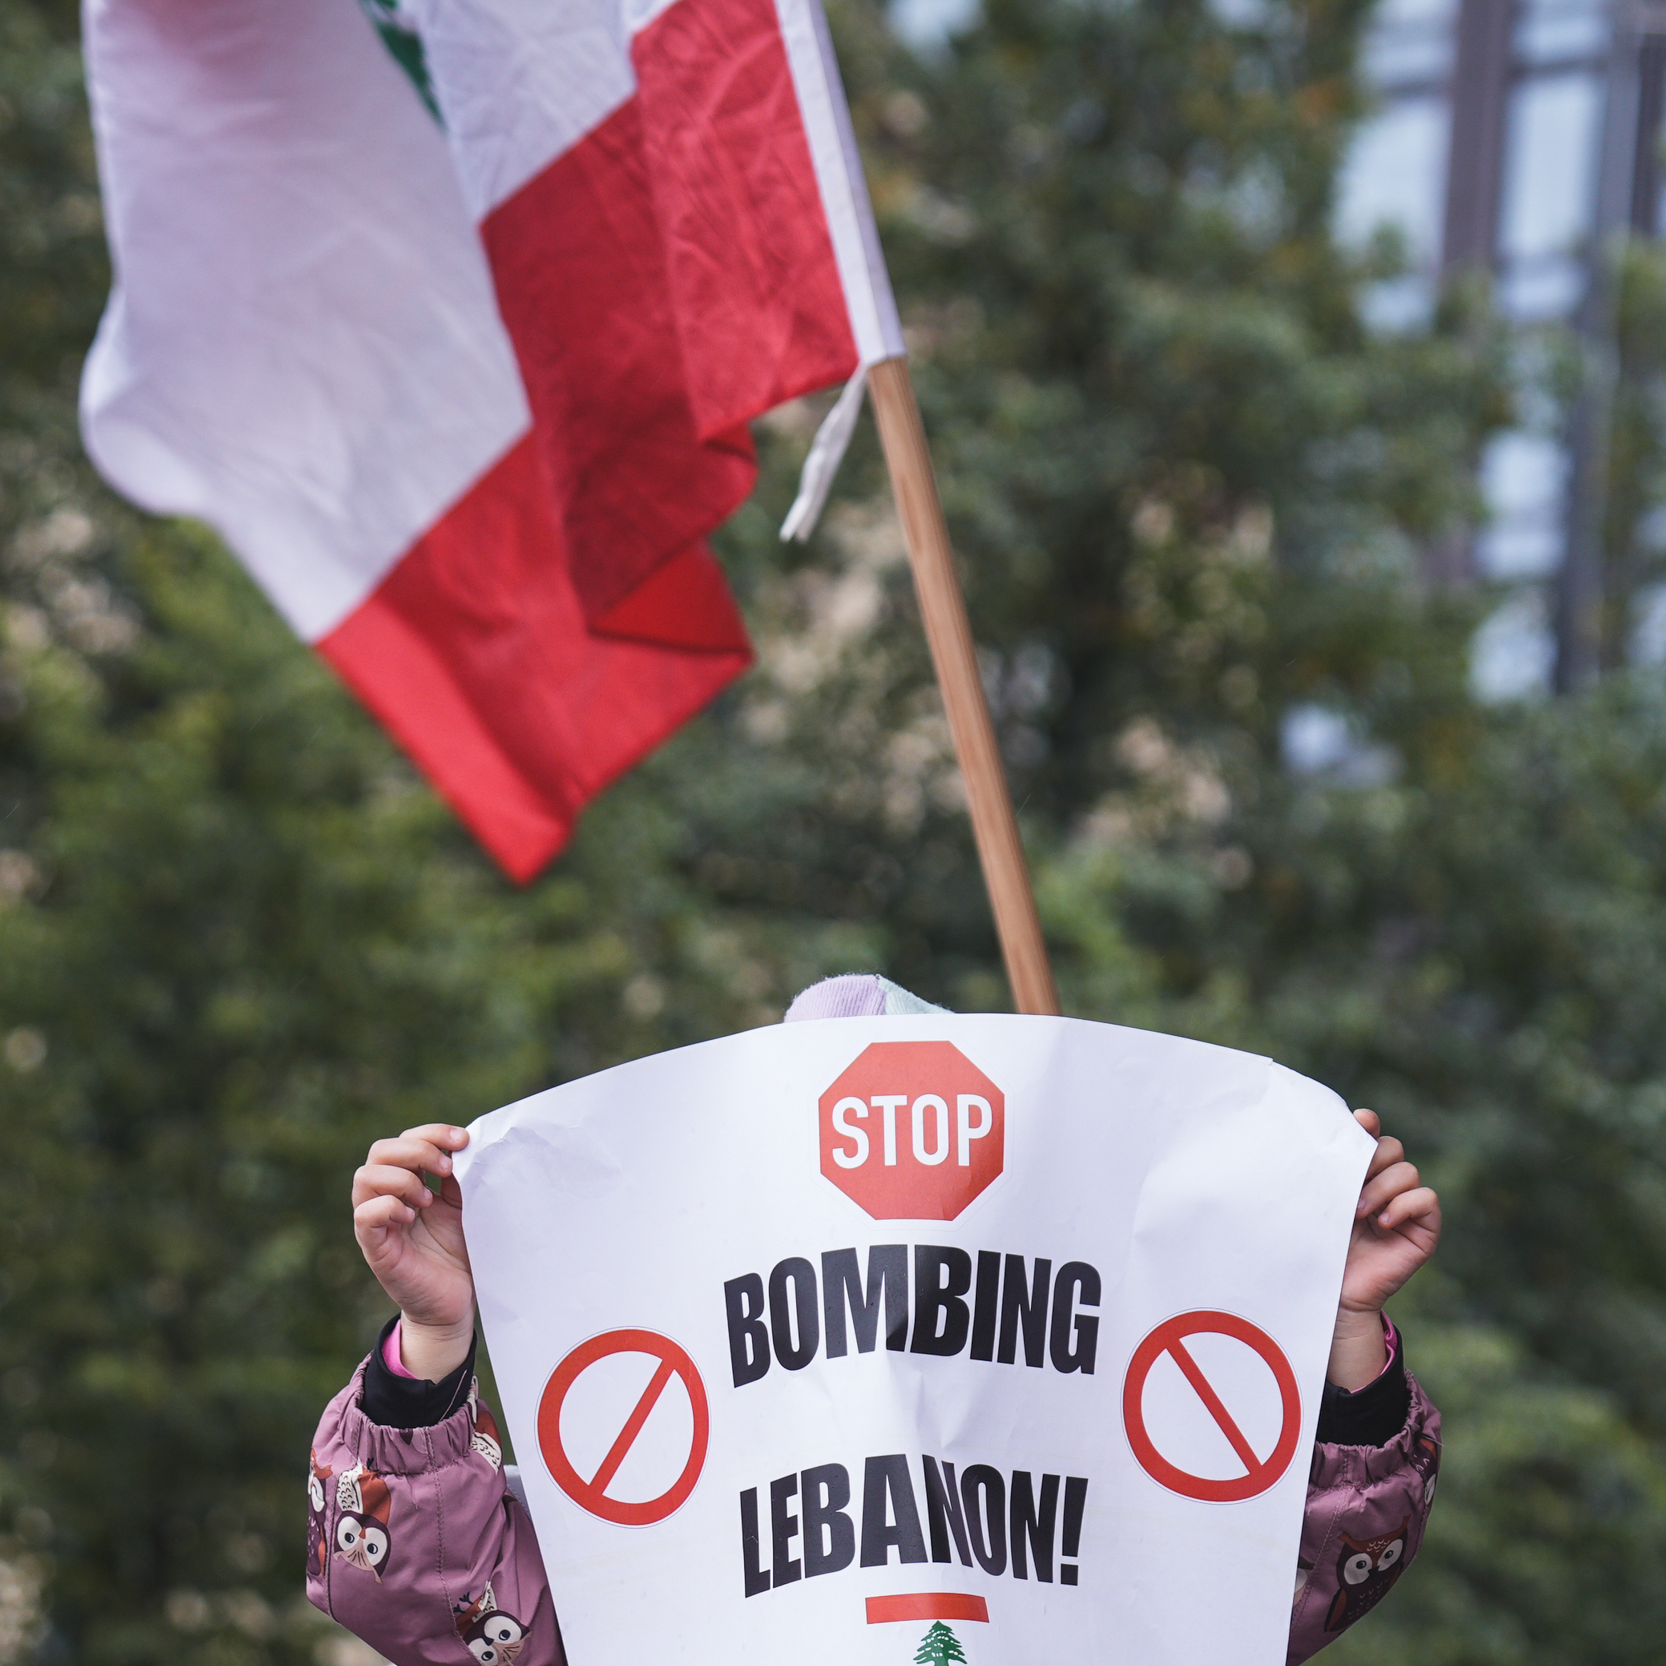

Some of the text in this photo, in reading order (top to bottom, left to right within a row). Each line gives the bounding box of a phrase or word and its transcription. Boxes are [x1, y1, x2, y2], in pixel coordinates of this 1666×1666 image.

[831, 1094, 994, 1170] STOP
[723, 1243, 1102, 1388] BOMBING
[739, 1453, 1089, 1598] LEBANON!
